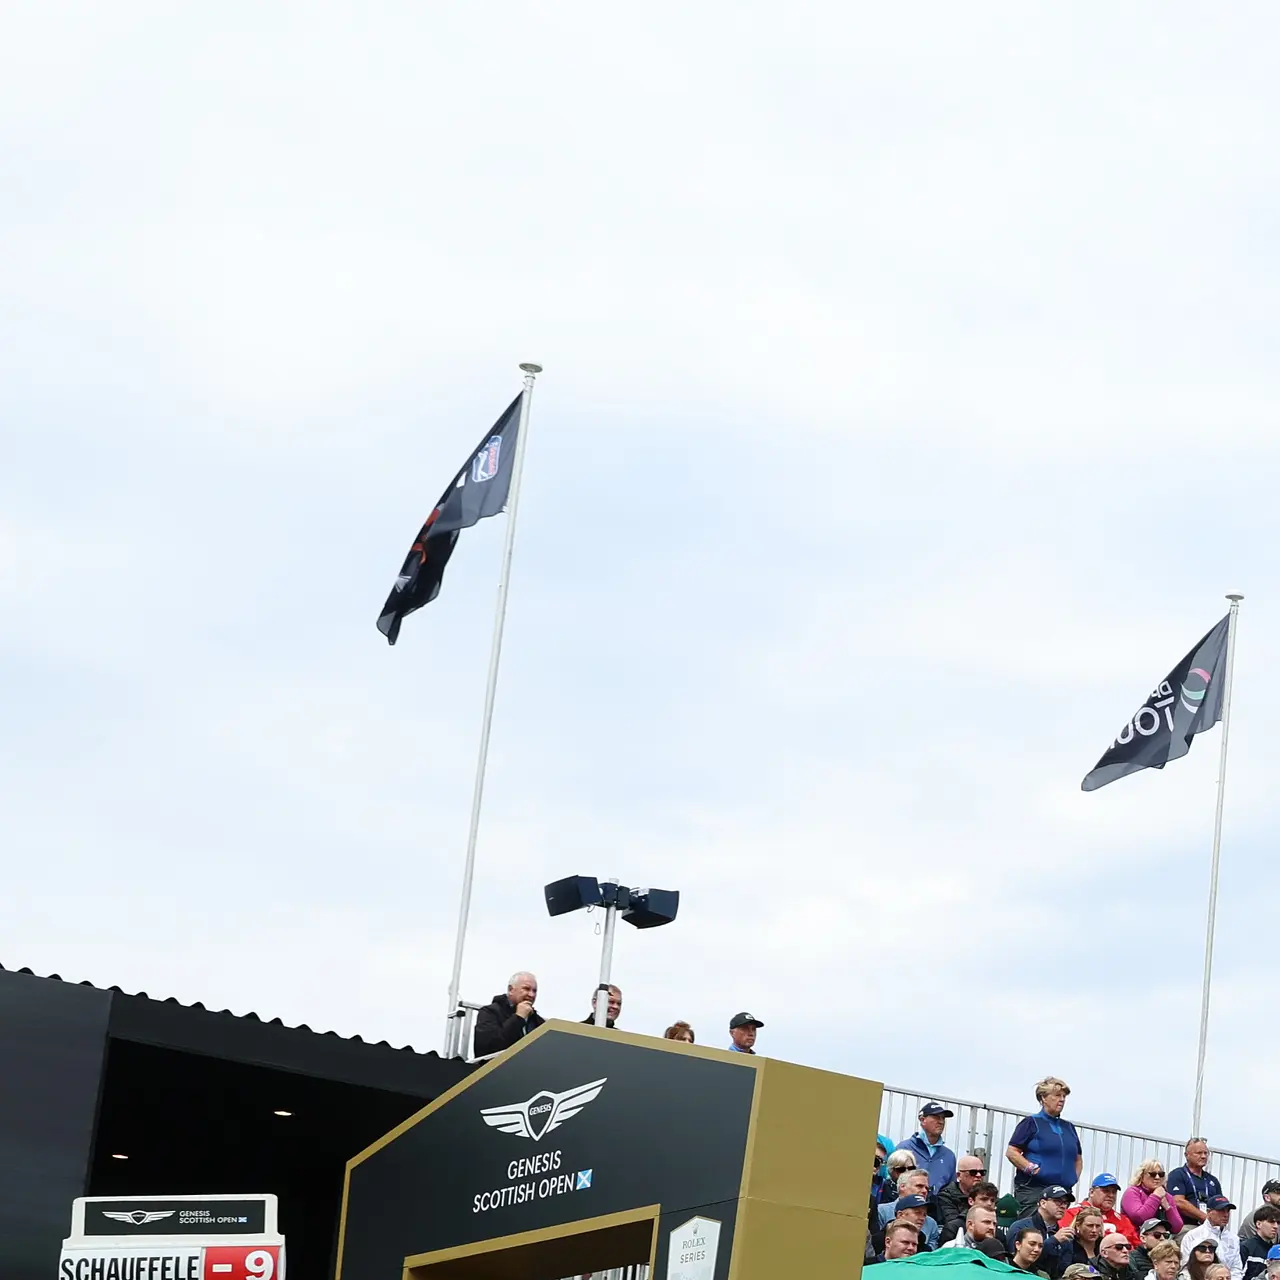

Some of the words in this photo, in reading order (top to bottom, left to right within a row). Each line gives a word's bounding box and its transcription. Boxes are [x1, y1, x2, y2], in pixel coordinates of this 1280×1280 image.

[529, 1102, 552, 1116] GENESIS
[507, 1150, 562, 1180] GENESIS
[472, 1181, 536, 1213] SCOTTISH
[539, 1173, 575, 1198] OPEN
[682, 1237, 706, 1249] ROLEX
[680, 1250, 706, 1264] SERIES
